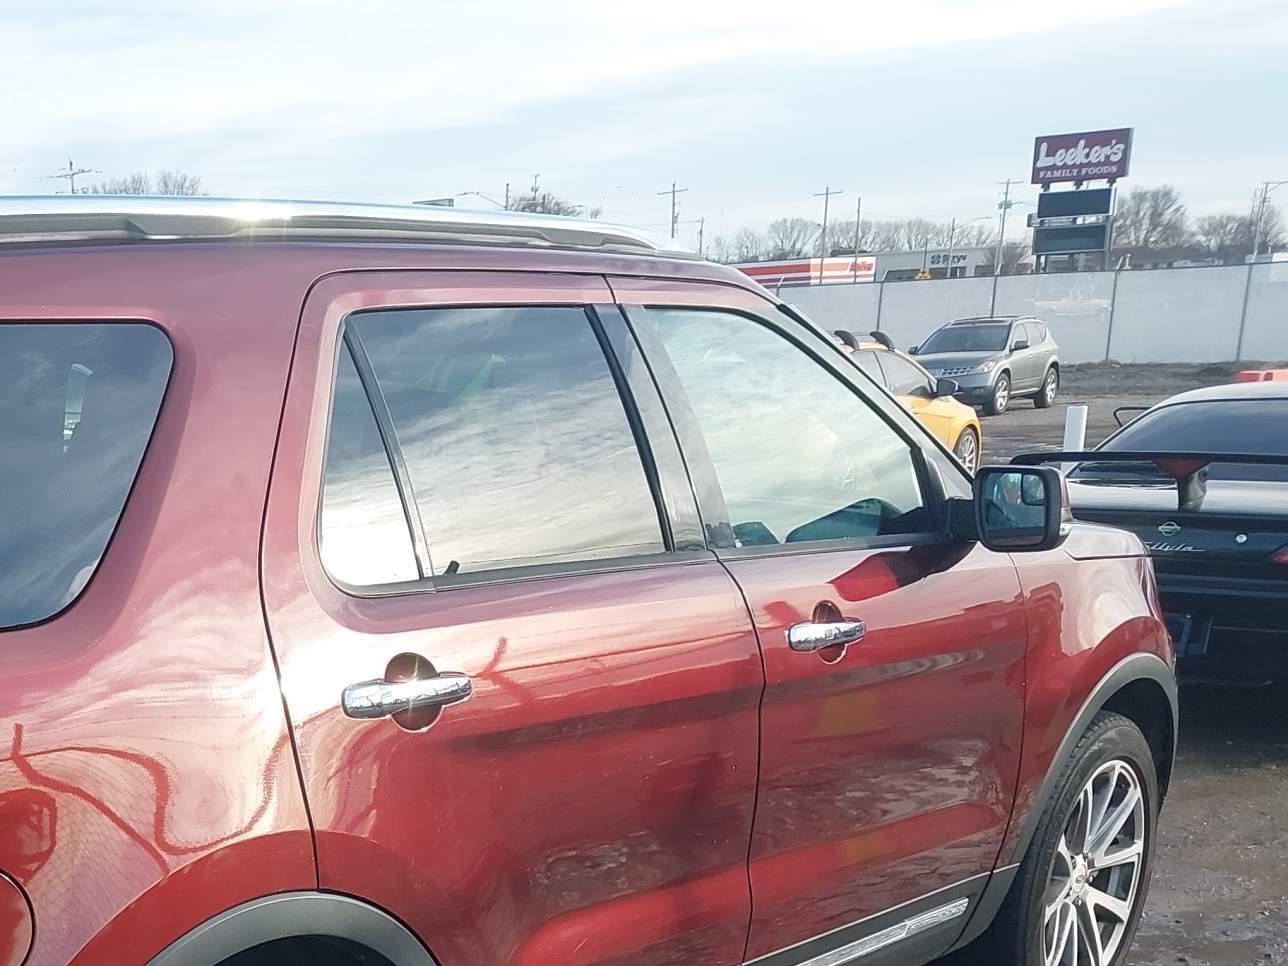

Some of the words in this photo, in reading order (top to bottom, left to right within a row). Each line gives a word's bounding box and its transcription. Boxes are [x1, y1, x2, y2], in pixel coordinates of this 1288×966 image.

[1036, 139, 1125, 167] Leeker's
[1039, 169, 1079, 178] FAMILY
[1081, 165, 1117, 175] FOODS
